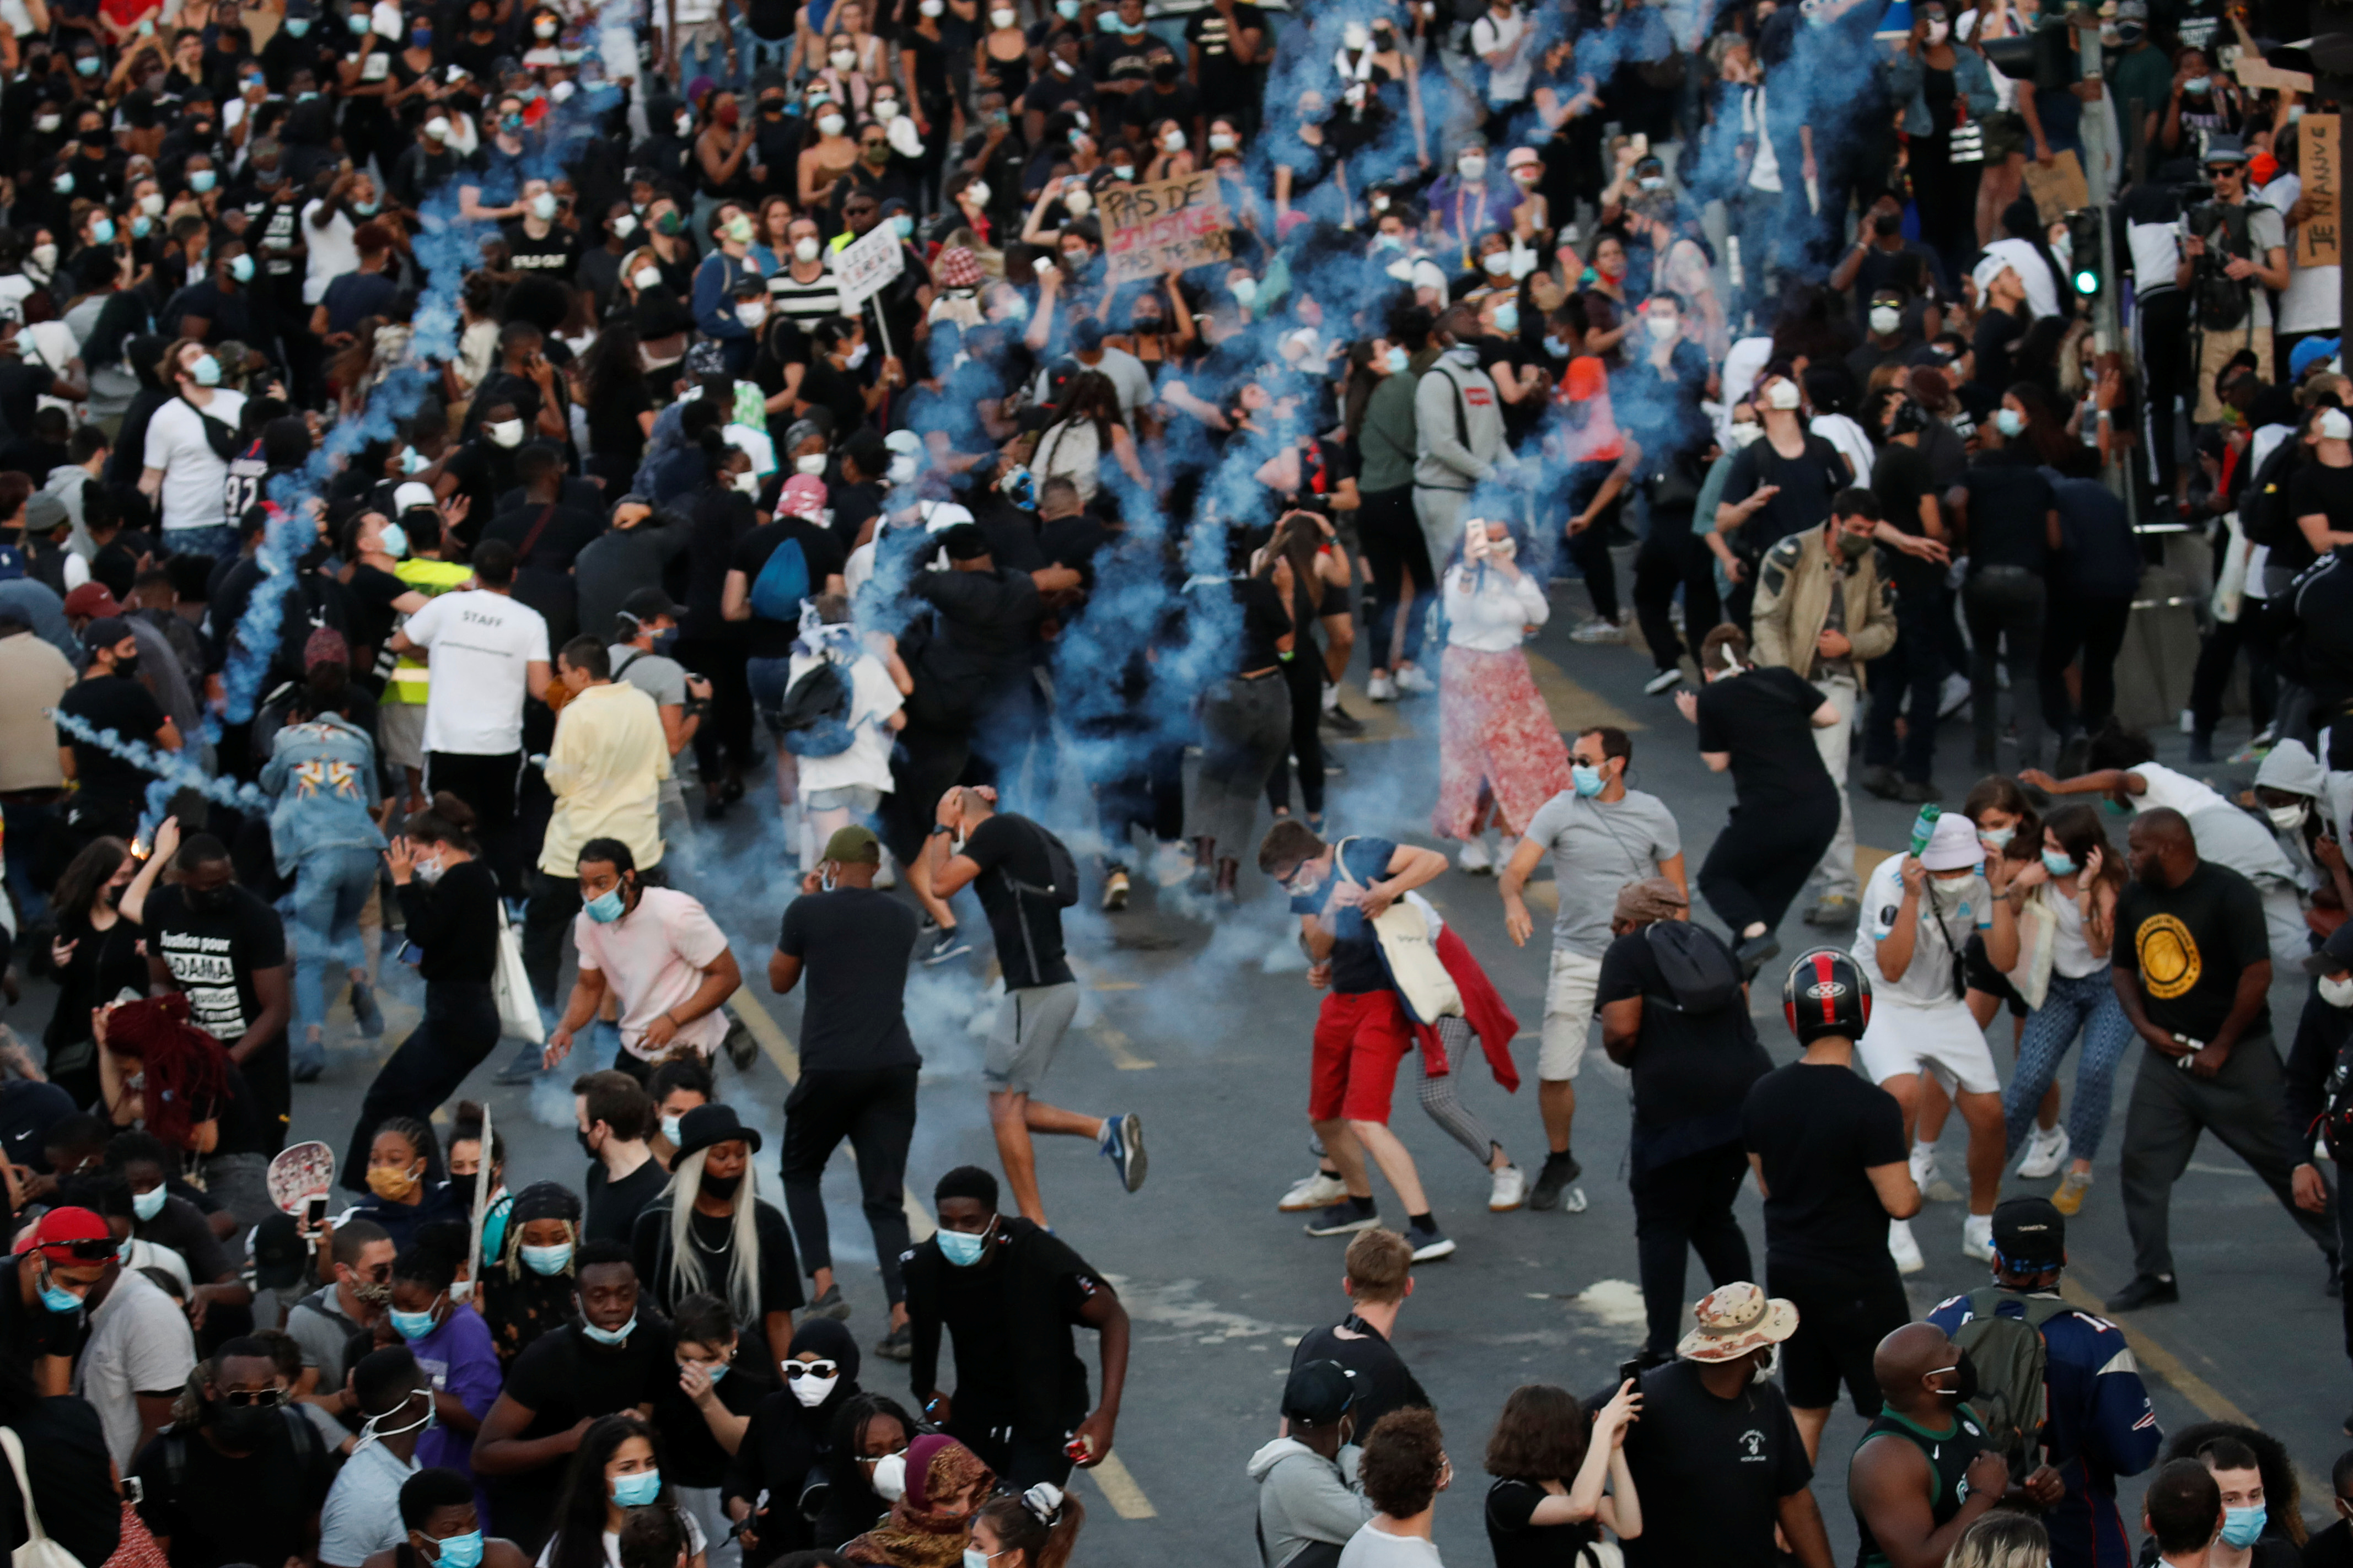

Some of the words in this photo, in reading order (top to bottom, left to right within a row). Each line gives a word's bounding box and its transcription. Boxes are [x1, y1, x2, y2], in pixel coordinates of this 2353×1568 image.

[1103, 190, 1158, 228] PAS
[1164, 178, 1202, 213] DE
[463, 610, 503, 628] STAFF
[201, 936, 230, 953] pour
